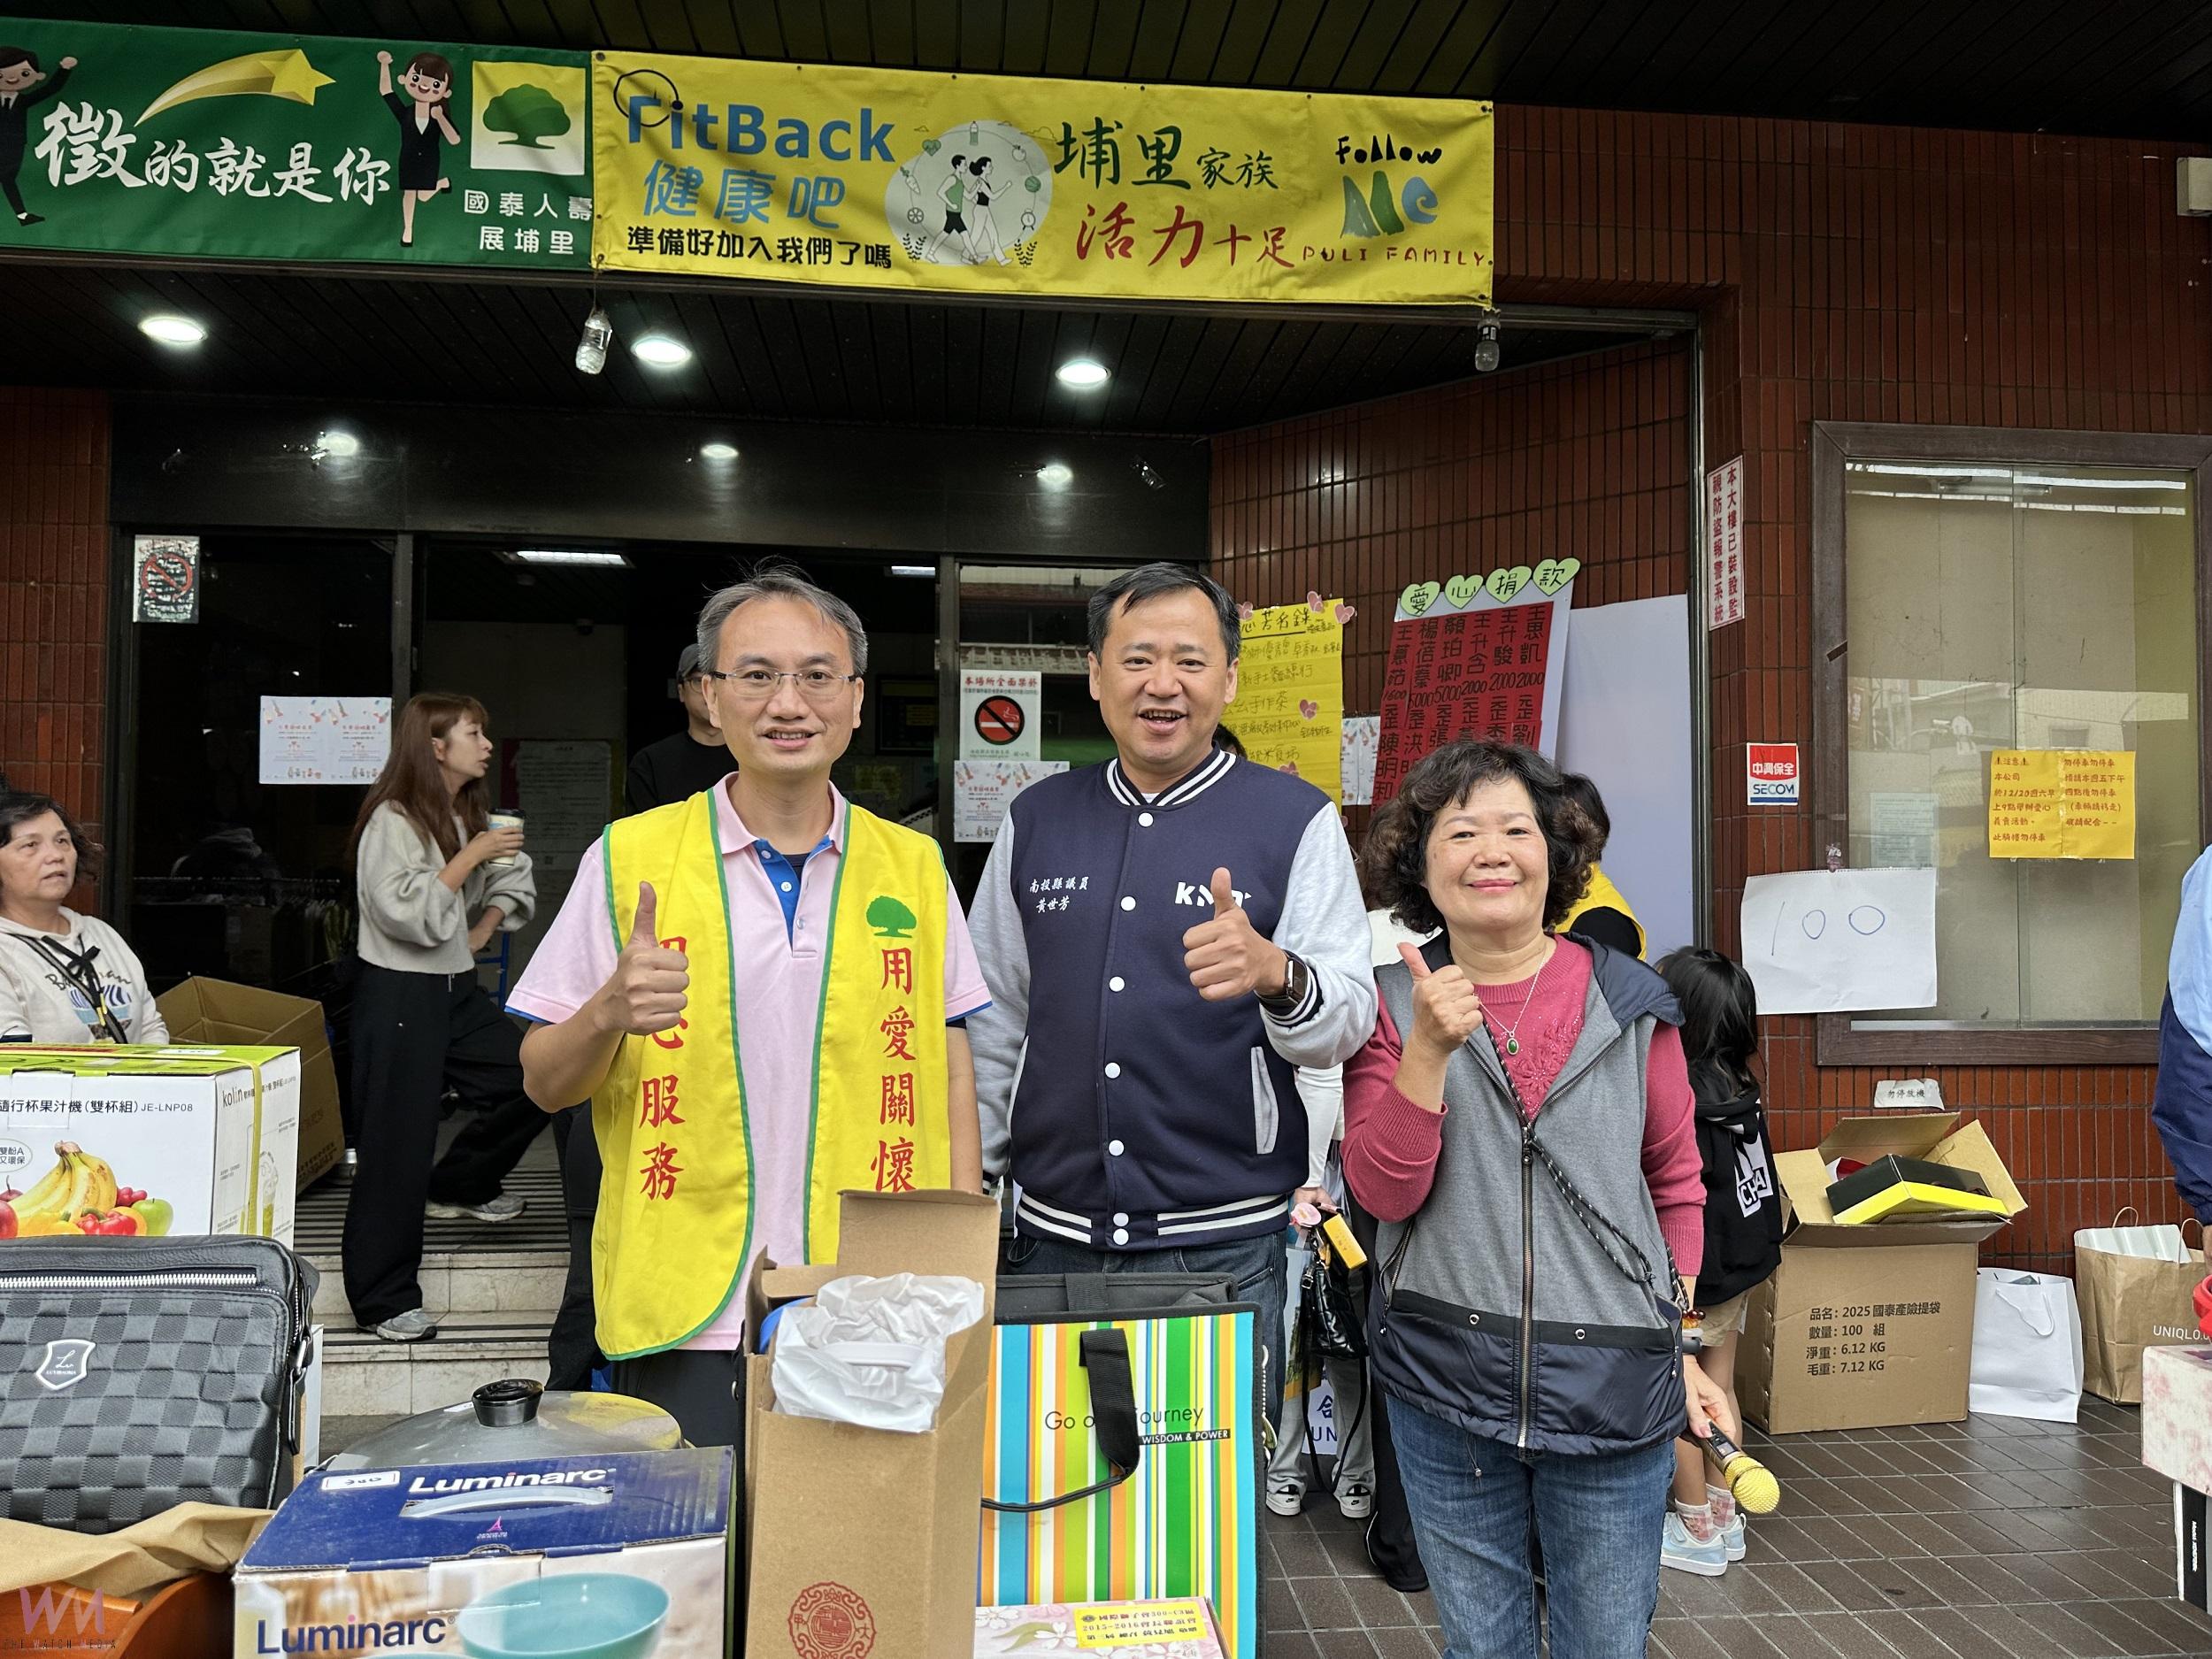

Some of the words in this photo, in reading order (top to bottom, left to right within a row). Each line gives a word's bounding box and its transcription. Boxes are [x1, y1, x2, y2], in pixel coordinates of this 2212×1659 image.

[627, 95, 896, 164] FitBack
[35, 100, 392, 206] 徵的就是你
[1054, 116, 1279, 190] 埔里家族
[1335, 134, 1443, 165] Follow
[464, 188, 593, 221] 國泰人壽
[643, 158, 846, 230] 健康吧
[479, 226, 574, 255] 展埔里
[1076, 201, 1295, 270] 活力十足
[627, 226, 892, 269] 準備好加入我們了嗎
[1302, 245, 1368, 263] PULI
[1386, 246, 1486, 267] FAMILY
[1712, 472, 1724, 624] 視防盜報警系統
[1726, 465, 1739, 619] 本大樓已裝設監
[1409, 568, 1566, 615] 愛心捐款
[2064, 758, 2116, 767] 勿停車勿停車
[1994, 772, 2021, 781] 本公司
[1753, 783, 1794, 795] SECOM
[1994, 789, 2055, 798] 於12/20週六早
[2065, 787, 2117, 797] 四點後勿停車
[1993, 833, 2047, 842] 此騎樓勿停車
[1029, 875, 1089, 894] 南投縣議員
[1035, 895, 1070, 914] 黃世芳
[1771, 902, 1886, 956] 100
[870, 946, 918, 1194] 用愛關懷
[141, 1102, 193, 1112] JE-LNP08
[221, 1087, 243, 1109] kolin
[1842, 1305, 1870, 1318] 2025
[1872, 1301, 1941, 1317] 國泰產險提袋
[1841, 1324, 1863, 1336] 100
[1872, 1323, 1886, 1336] 組
[1840, 1342, 1866, 1355] 6.12
[1870, 1341, 1886, 1353] KG
[1840, 1361, 1865, 1373] 7.12
[1869, 1360, 1885, 1371] KG
[1045, 1411, 1075, 1430] Go
[1135, 1408, 1204, 1426] ourney
[1141, 1433, 1182, 1445] WISDOM
[1195, 1430, 1228, 1440] POWER
[408, 1469, 607, 1493] Luminarc
[257, 1617, 445, 1654] Luminarc
